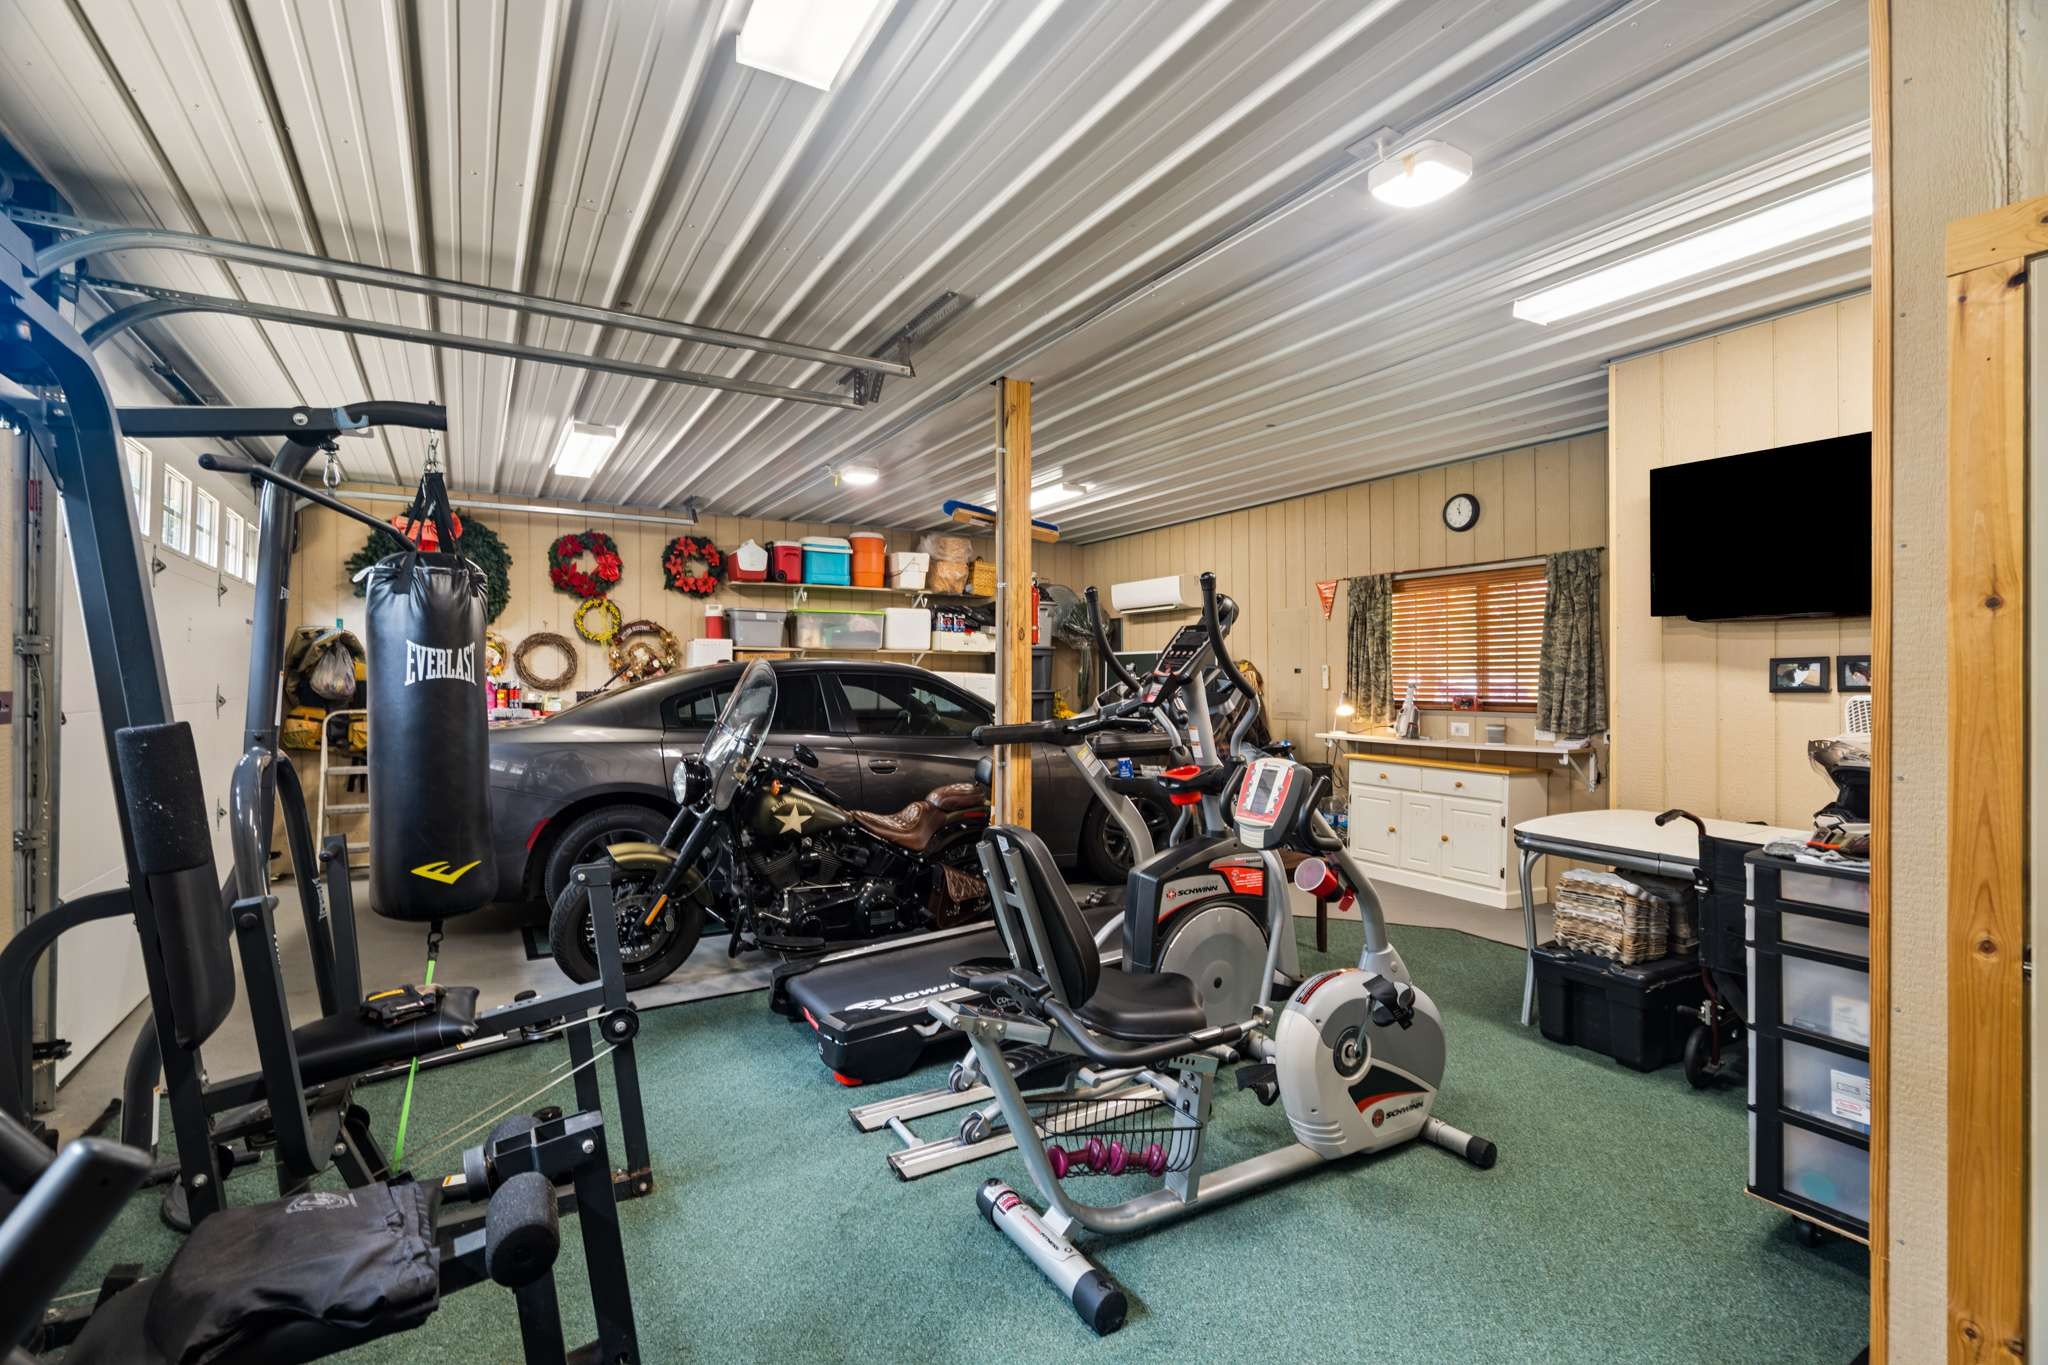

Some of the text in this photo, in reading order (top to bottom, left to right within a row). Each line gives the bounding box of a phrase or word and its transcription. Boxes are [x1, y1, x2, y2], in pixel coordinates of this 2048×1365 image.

[404, 639, 477, 686] EVERLAST
[1178, 884, 1218, 897] SCHWINN
[890, 982, 960, 1003] BOWFL
